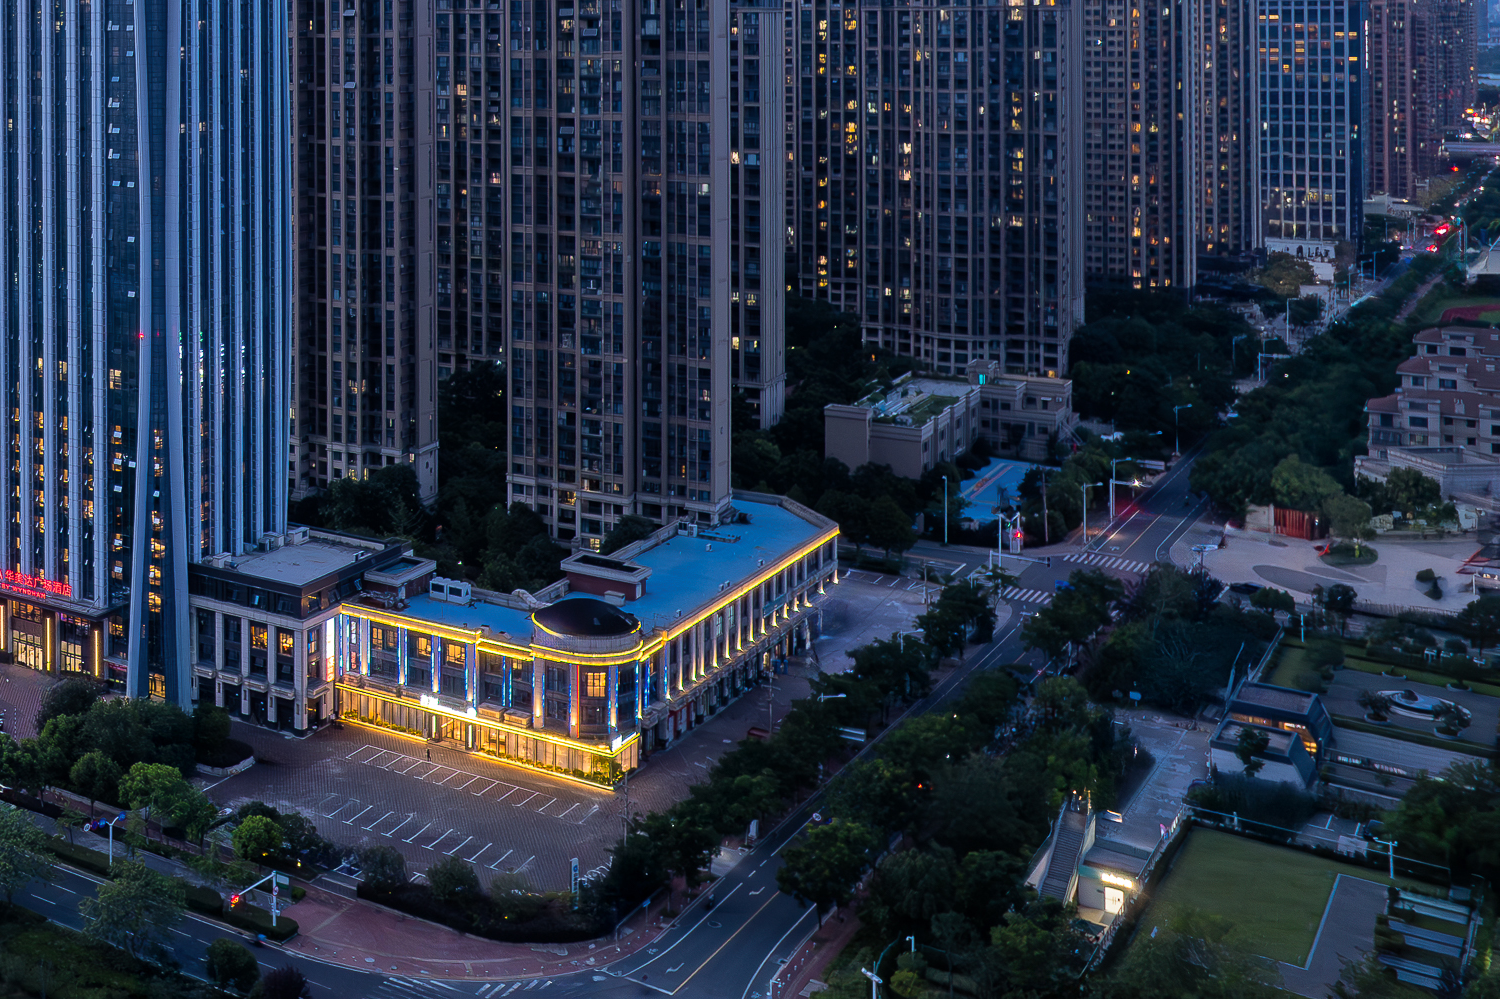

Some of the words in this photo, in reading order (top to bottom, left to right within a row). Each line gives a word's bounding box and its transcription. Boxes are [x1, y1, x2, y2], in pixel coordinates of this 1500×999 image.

[5, 569, 72, 598] 华美达广场酒店
[12, 586, 46, 600] WYNDHAM
